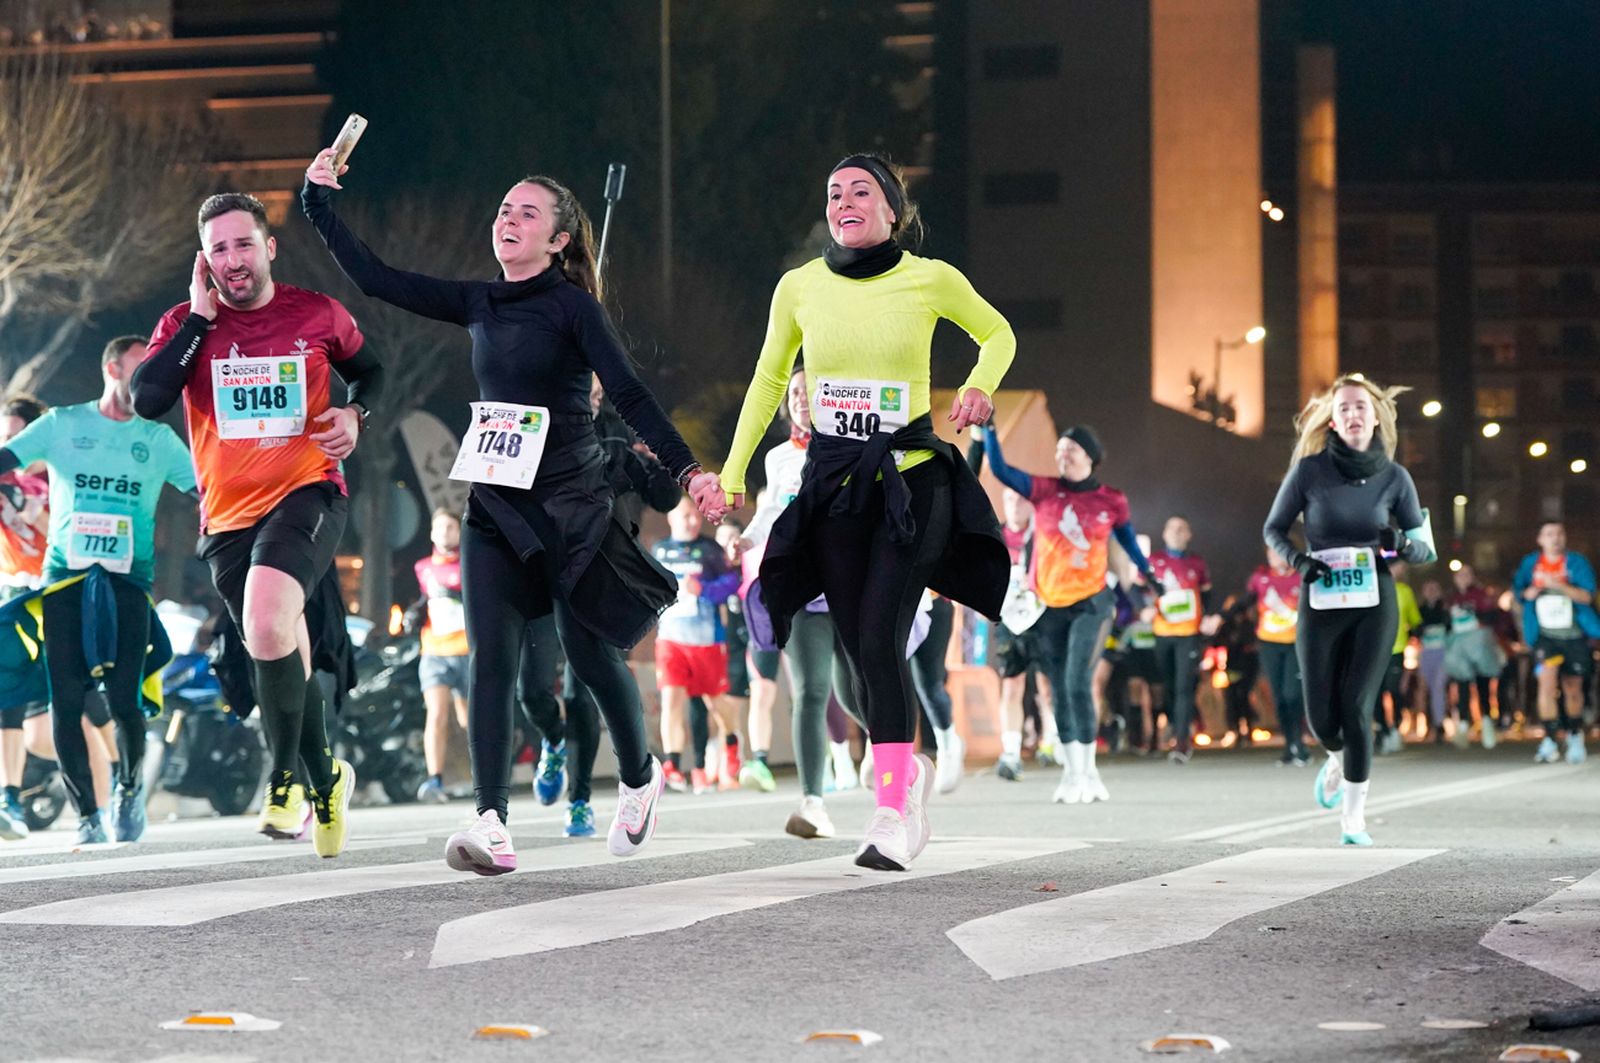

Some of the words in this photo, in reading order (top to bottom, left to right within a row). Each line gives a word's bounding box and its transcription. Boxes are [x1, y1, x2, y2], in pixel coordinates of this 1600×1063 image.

[233, 367, 258, 376] NOCHE
[260, 366, 270, 374] DE
[224, 378, 240, 387] SAN
[233, 385, 287, 411] 9148
[821, 398, 836, 407] SAN
[831, 389, 859, 399] NOCHE
[860, 390, 871, 399] DE
[834, 411, 881, 437] 340
[477, 430, 522, 458] 1748
[75, 473, 142, 496] serás
[85, 534, 118, 553] 7712
[1324, 569, 1363, 588] 8159
